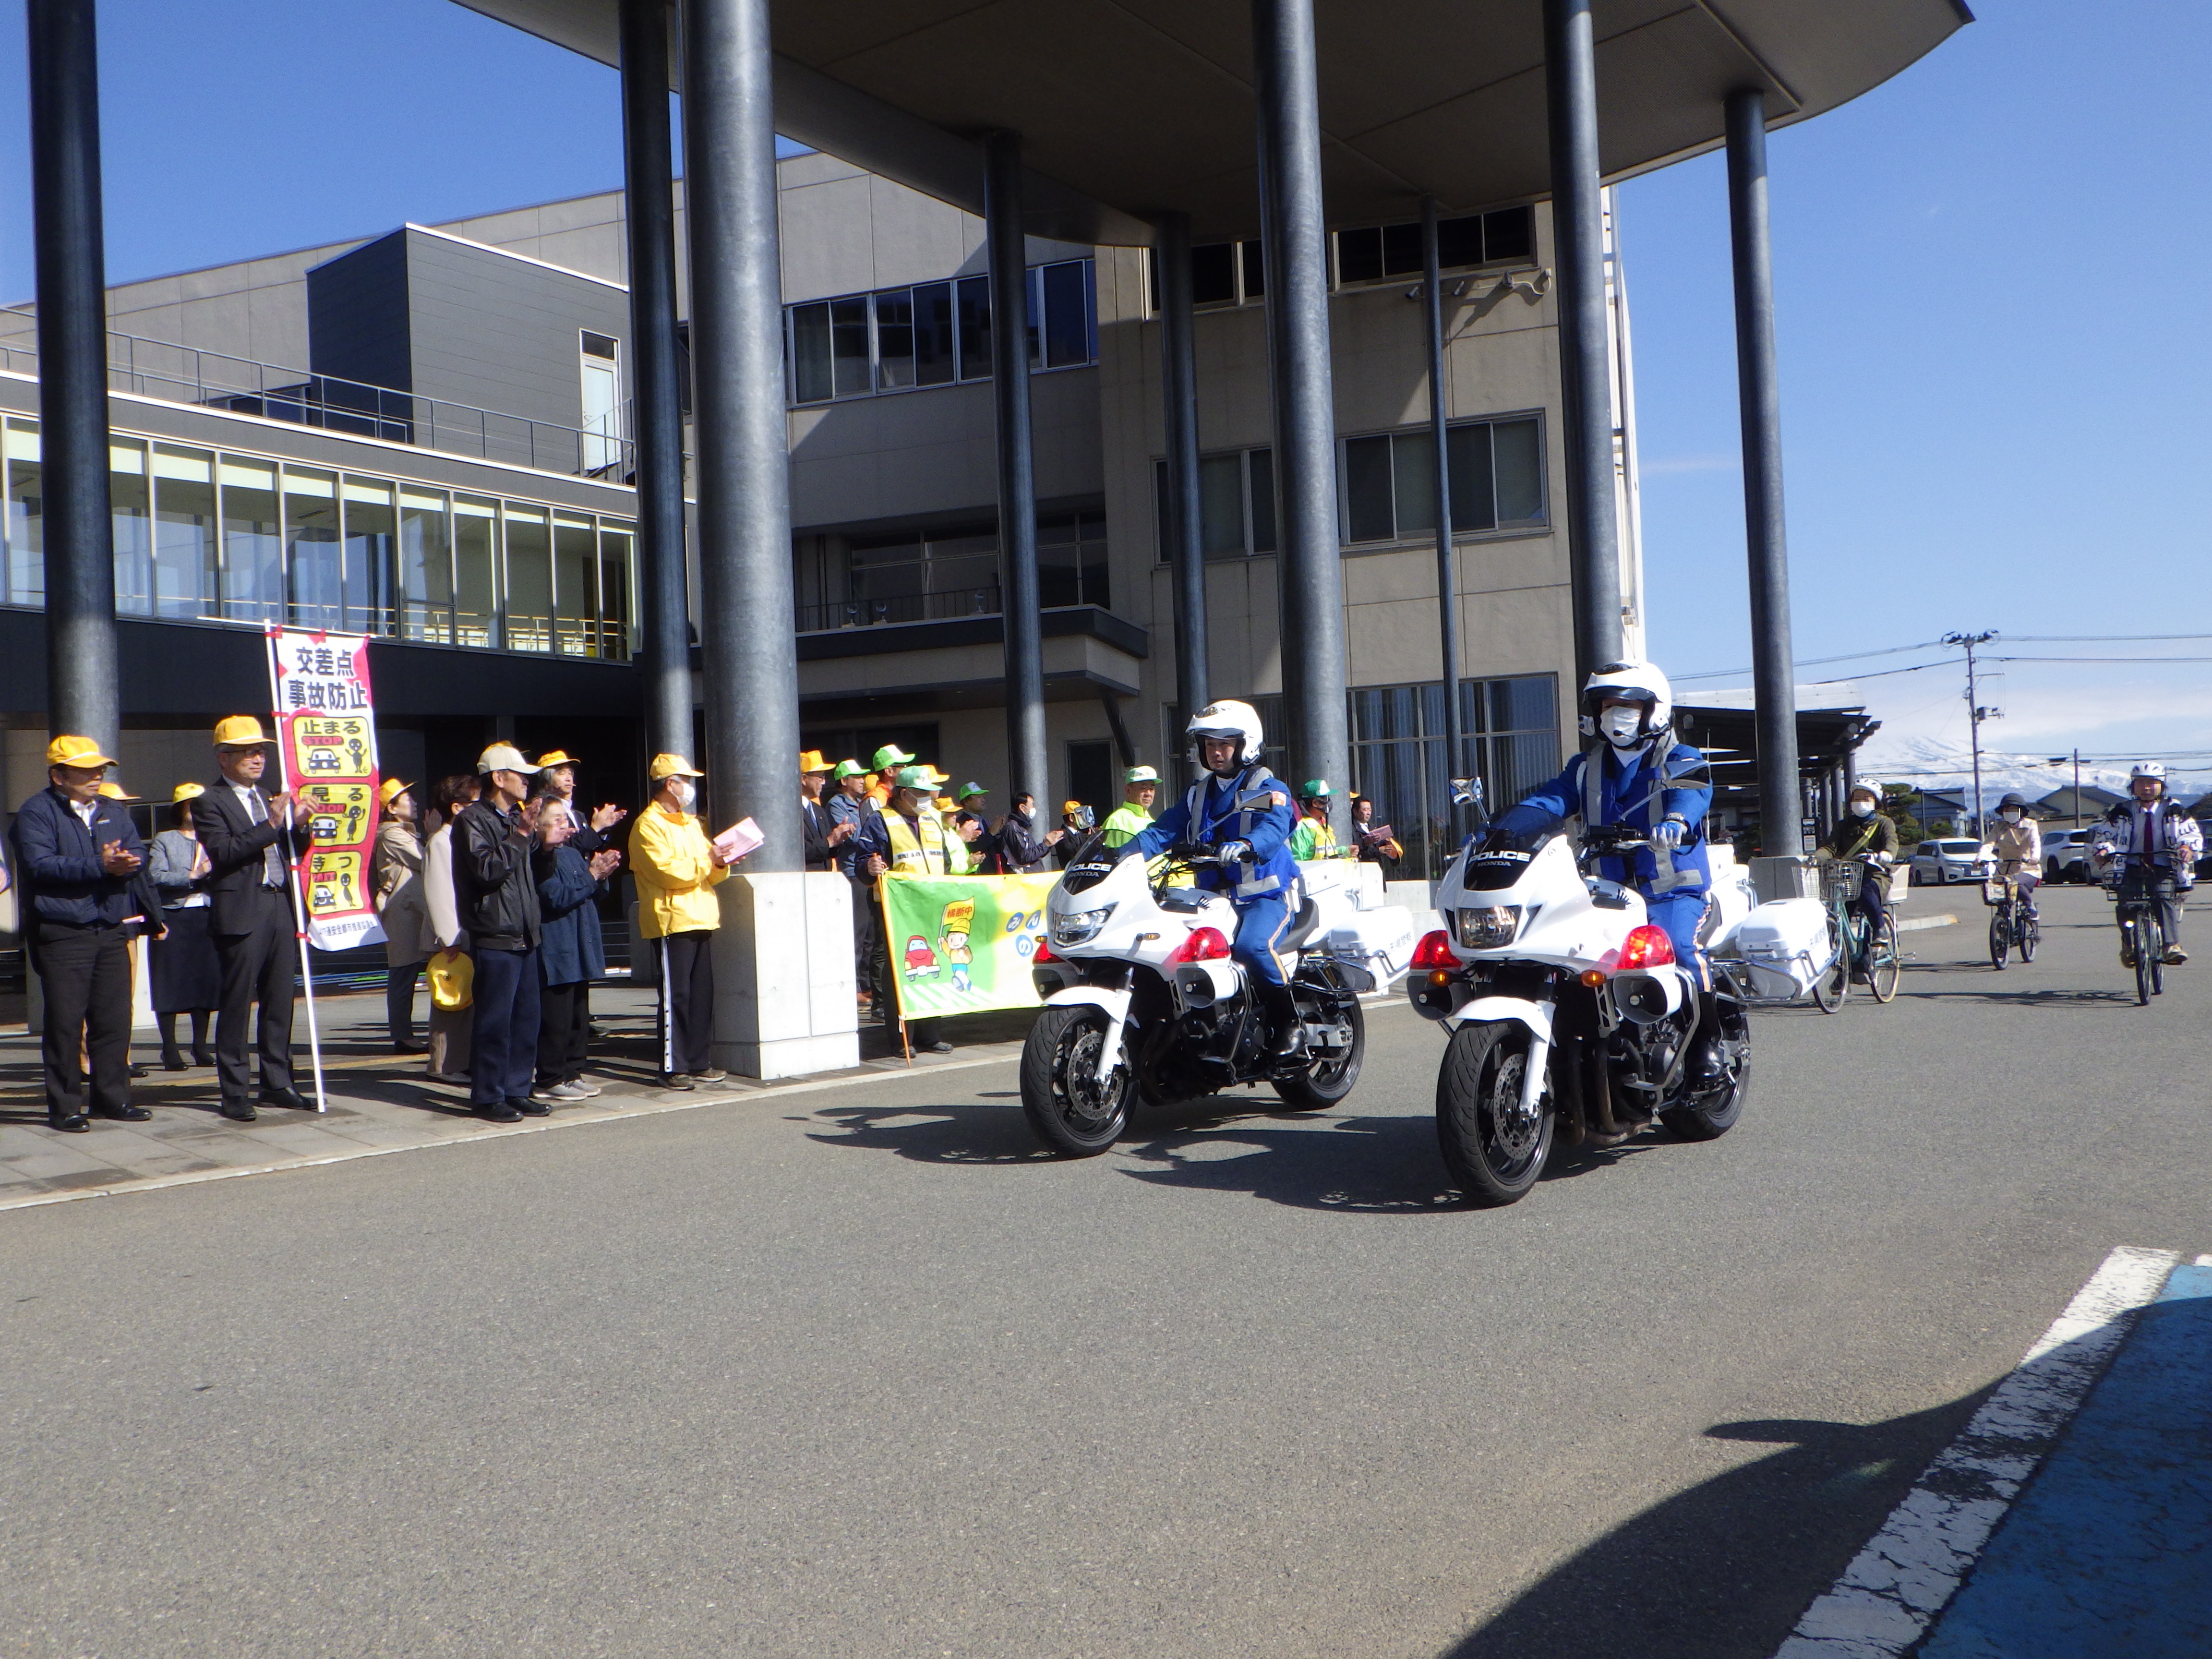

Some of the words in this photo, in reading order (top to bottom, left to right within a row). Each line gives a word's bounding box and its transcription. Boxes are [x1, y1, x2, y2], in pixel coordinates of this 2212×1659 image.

[296, 647, 354, 676] 交差点
[288, 679, 367, 710] 事故防止
[303, 720, 361, 734] 止まる
[302, 736, 343, 745] STOP
[312, 787, 363, 802] 見る
[316, 804, 345, 813] OOK
[1468, 851, 1531, 864] POLICE
[1067, 863, 1112, 872] POLICE
[947, 906, 973, 918] 横断中
